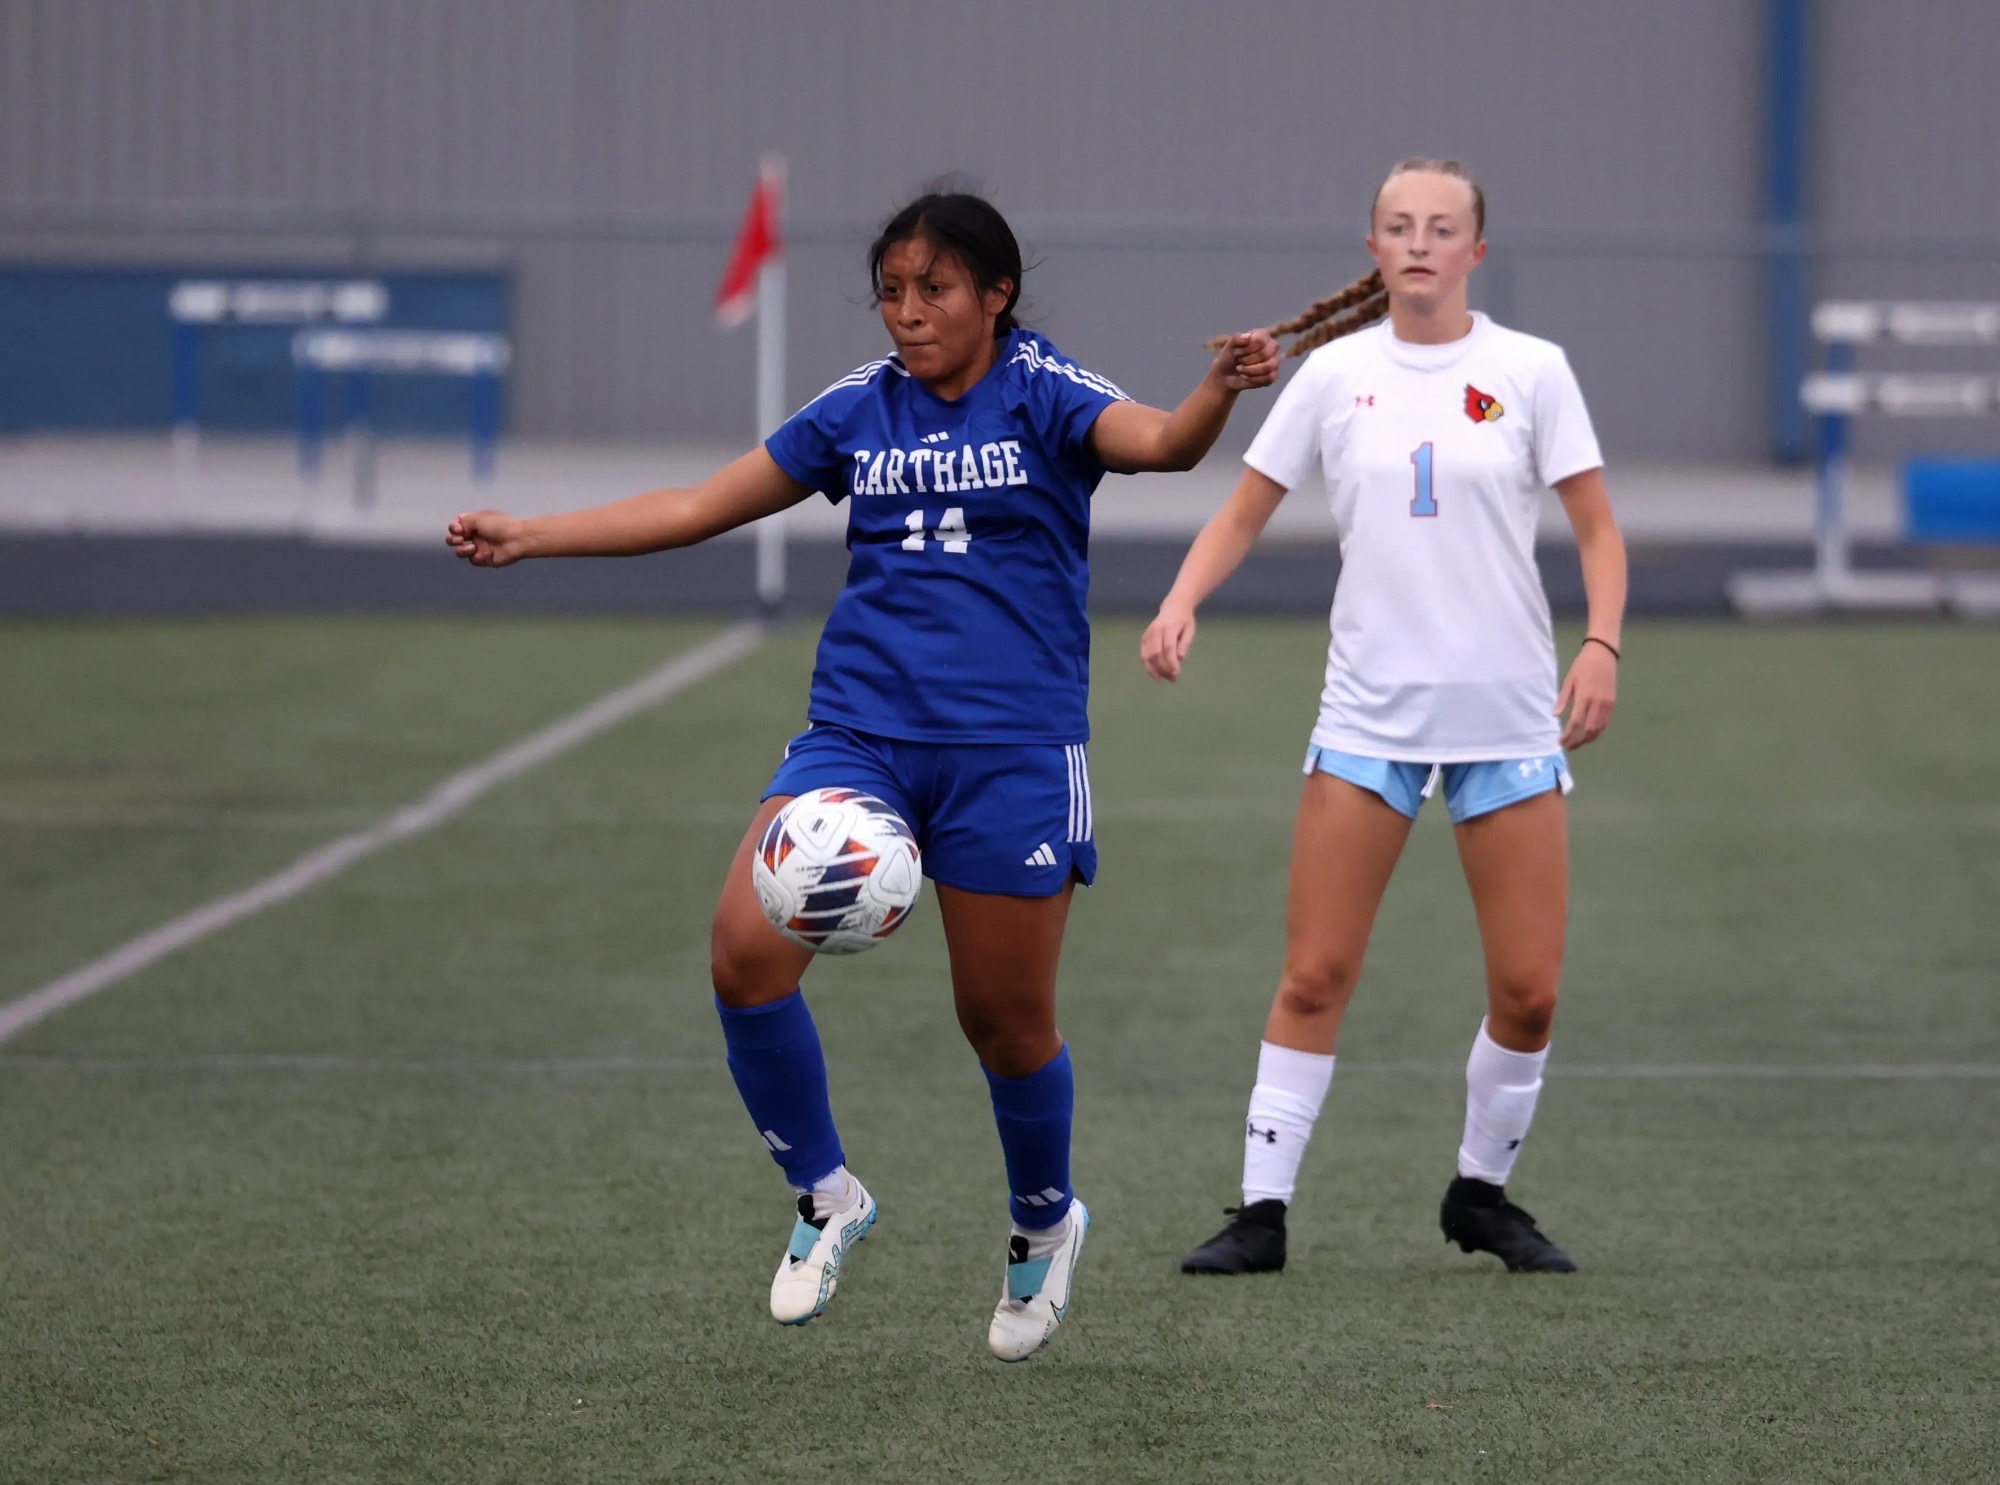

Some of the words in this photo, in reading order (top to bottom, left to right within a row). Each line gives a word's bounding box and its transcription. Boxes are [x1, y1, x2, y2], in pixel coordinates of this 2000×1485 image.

[853, 440, 1028, 495] CARTHAGE
[1410, 441, 1438, 517] 1
[901, 507, 972, 554] 14
